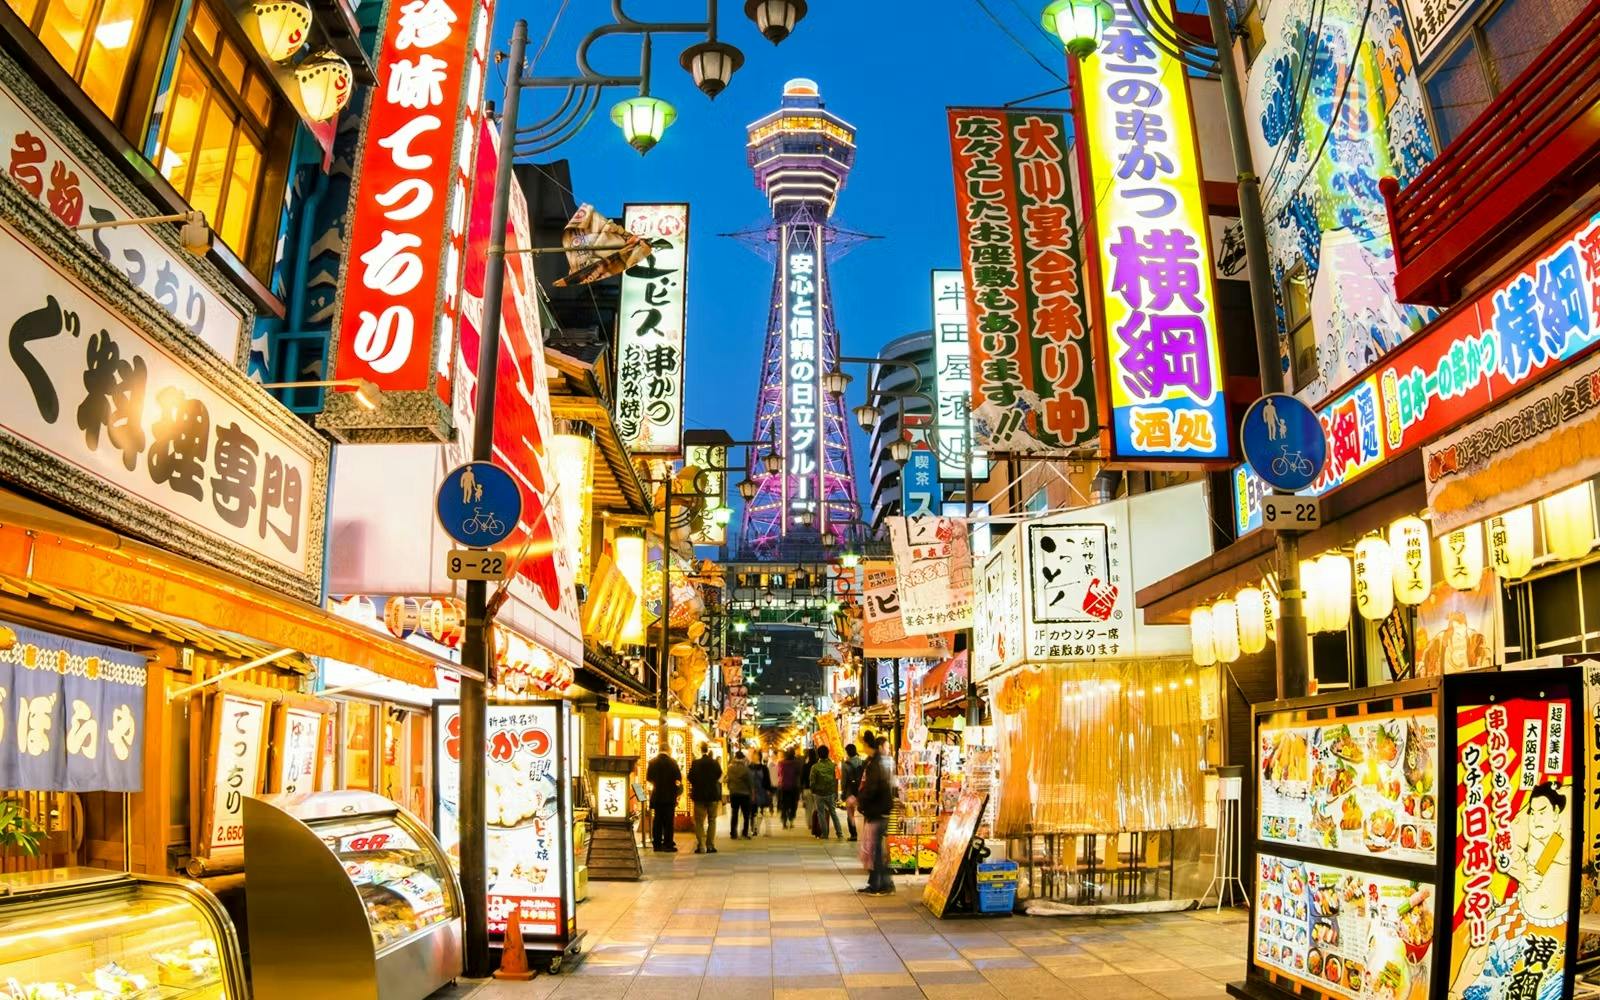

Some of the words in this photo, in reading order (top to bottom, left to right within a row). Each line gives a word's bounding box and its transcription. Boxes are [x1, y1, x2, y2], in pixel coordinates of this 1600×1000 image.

[620, 345, 641, 436] お好み焼き
[645, 345, 677, 421] 串かつ
[1134, 410, 1213, 449] 酒処
[1049, 644, 1120, 657] 座敷あります
[1050, 628, 1120, 641] カウンター席
[226, 711, 250, 814] てっちり
